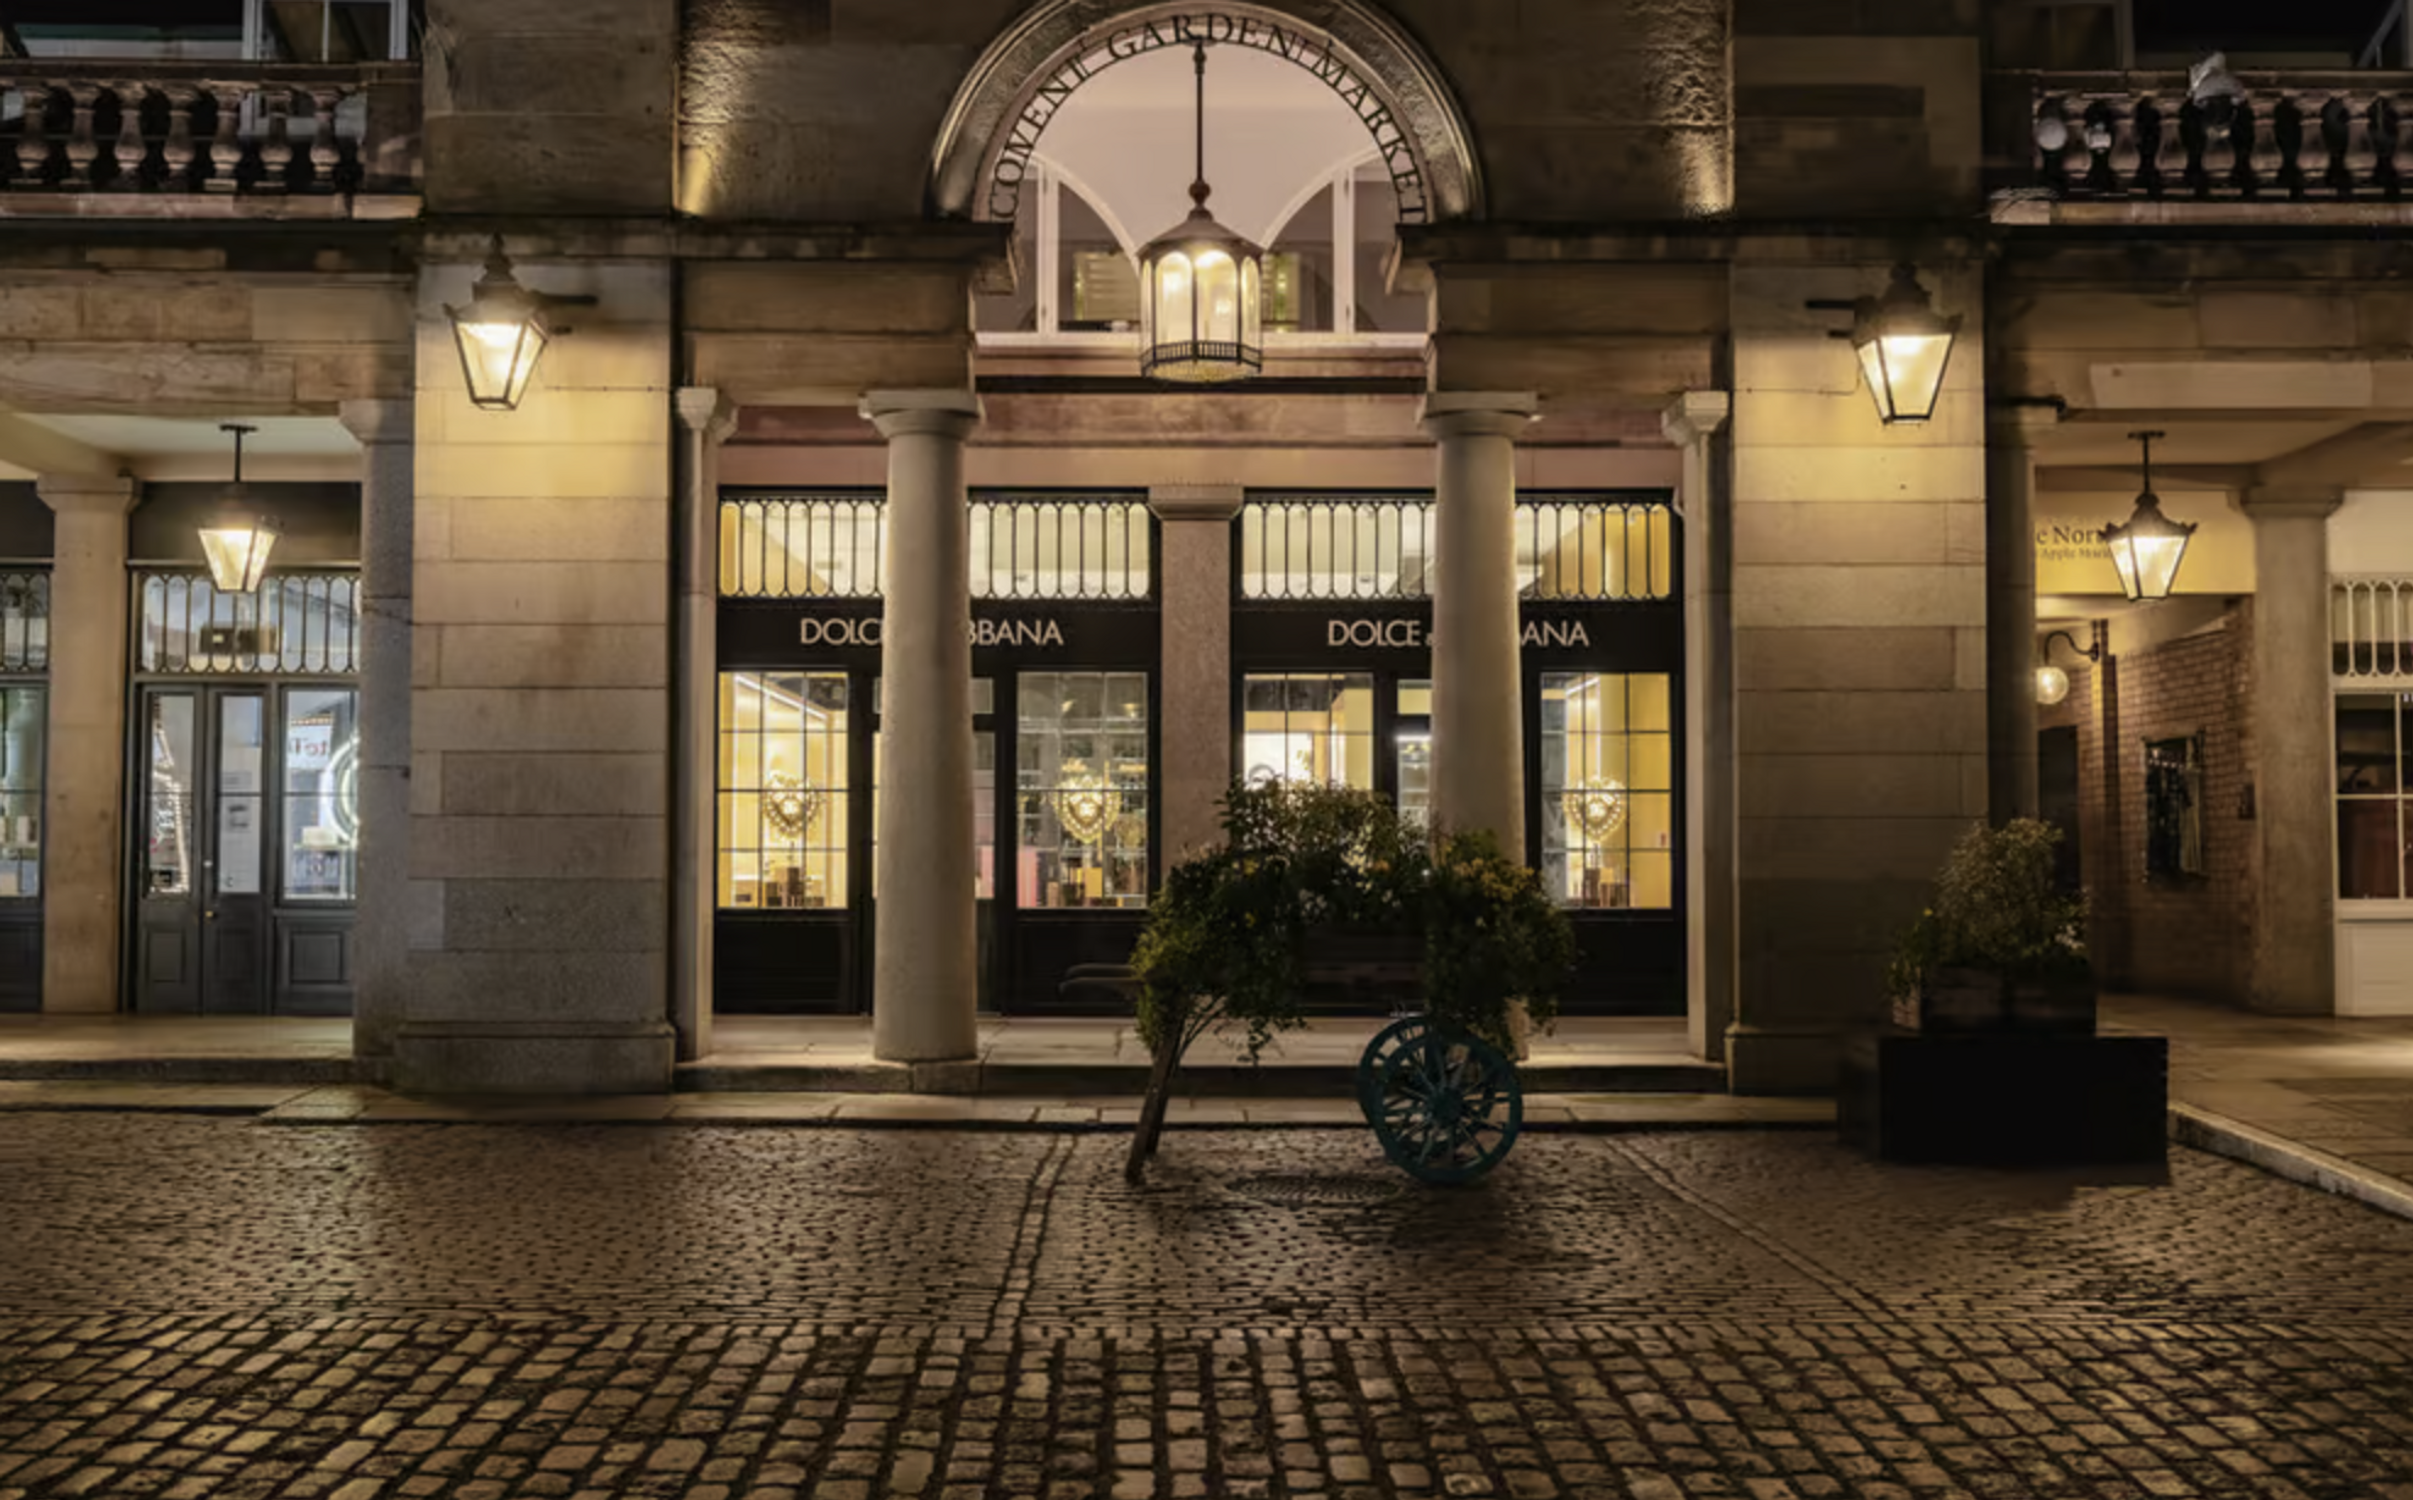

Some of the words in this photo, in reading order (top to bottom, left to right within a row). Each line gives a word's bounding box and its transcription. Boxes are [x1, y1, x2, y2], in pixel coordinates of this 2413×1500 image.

[990, 45, 1091, 218] COVENT
[1107, 12, 1300, 62] GARDEN
[1310, 43, 1428, 222] MARKET
[800, 617, 883, 646] DOLC
[1327, 619, 1421, 647] DOLCE
